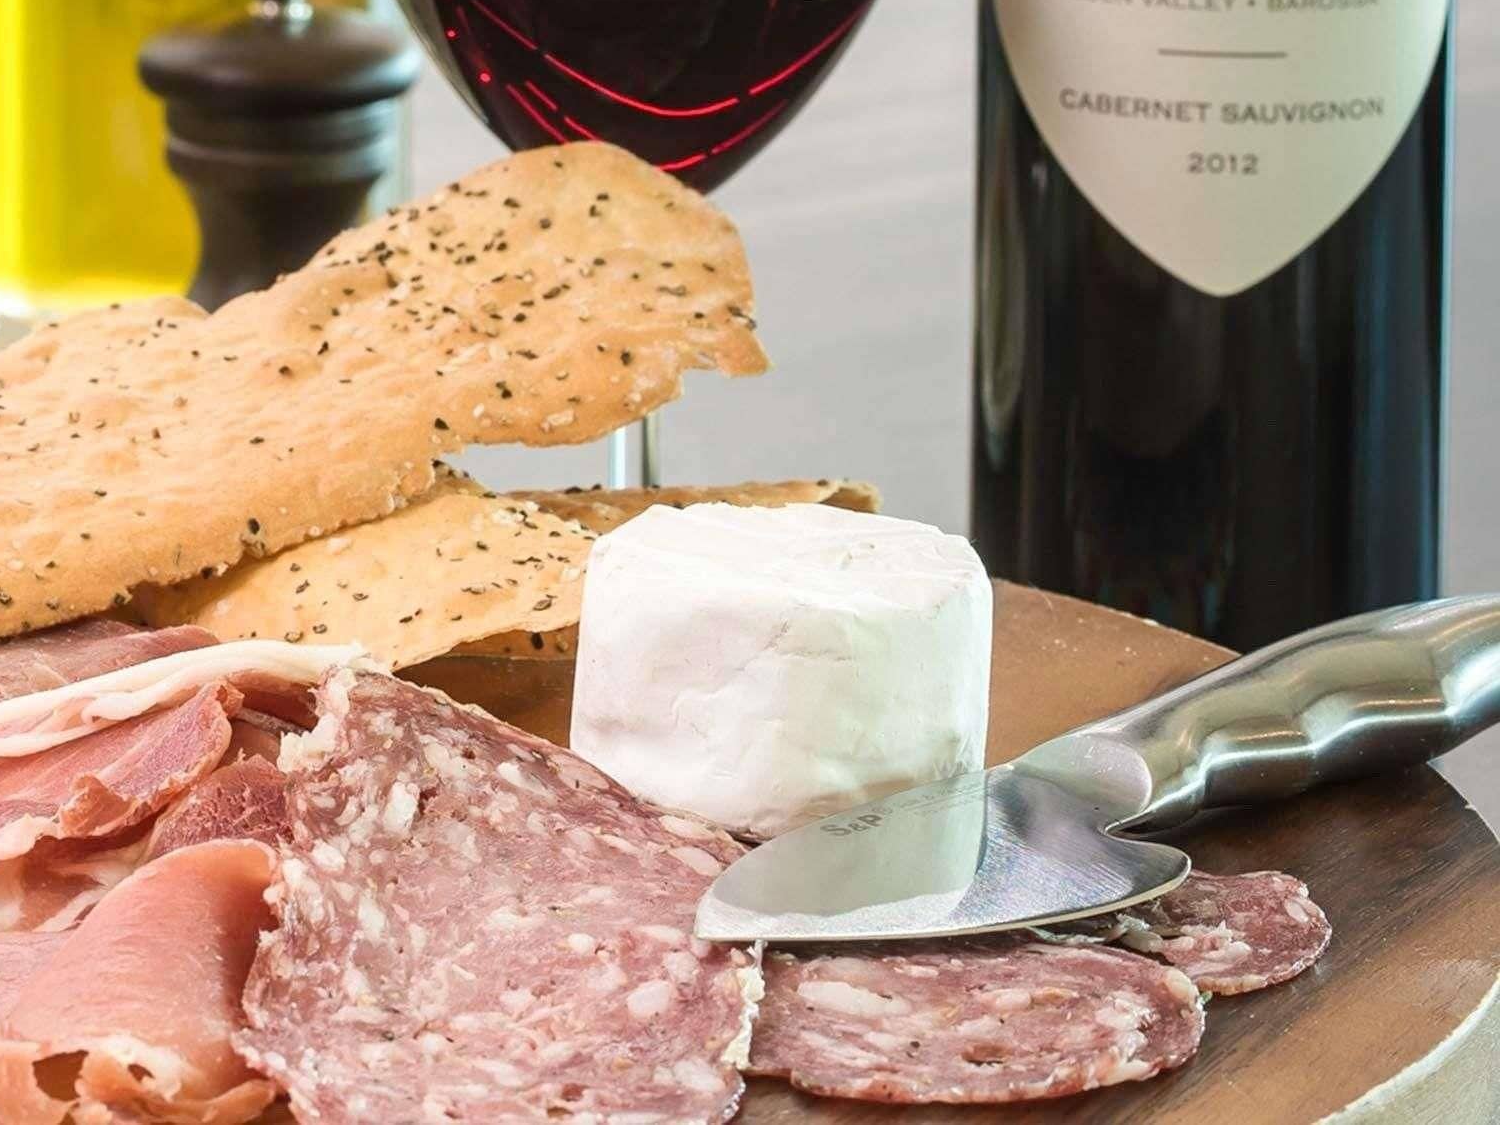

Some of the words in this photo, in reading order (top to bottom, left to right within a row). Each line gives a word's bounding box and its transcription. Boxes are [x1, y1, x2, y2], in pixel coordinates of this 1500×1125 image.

[1059, 87, 1213, 123] CABERNET
[1221, 96, 1385, 124] SAUVIGNON
[1188, 151, 1259, 175] 2012
